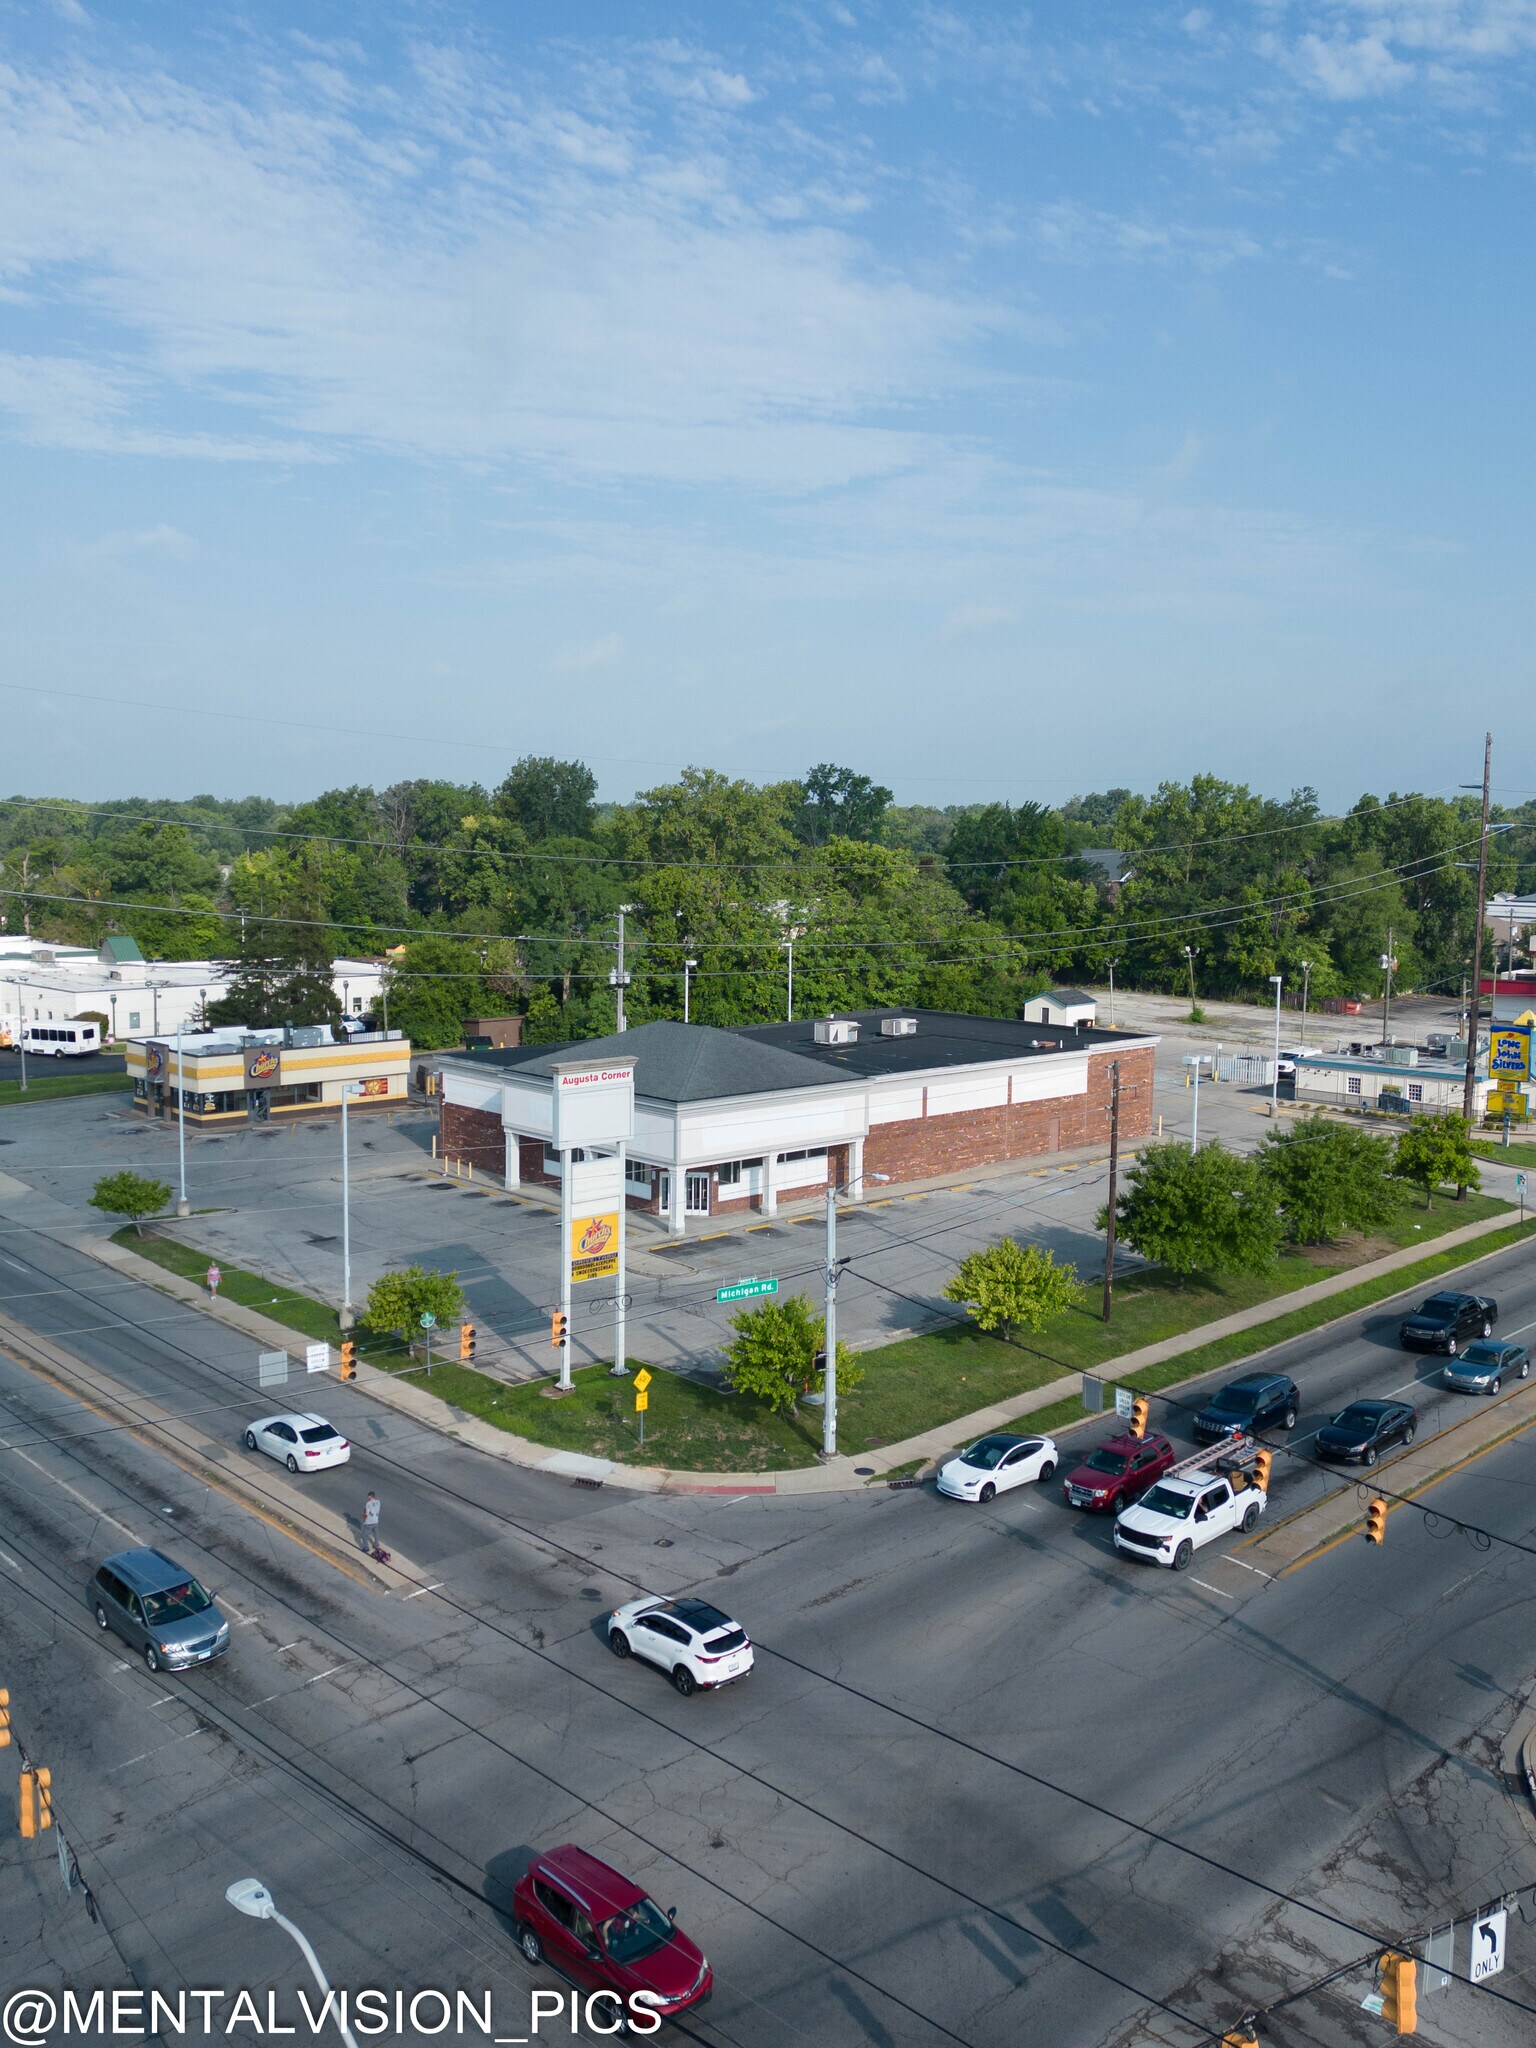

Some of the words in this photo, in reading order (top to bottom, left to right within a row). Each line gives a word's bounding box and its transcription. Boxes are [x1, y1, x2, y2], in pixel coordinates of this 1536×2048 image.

[562, 1074, 599, 1086] Augusta
[601, 1071, 631, 1080] Corner
[721, 1286, 759, 1299] Michigan
[761, 1283, 774, 1292] Rd.
[1475, 1953, 1500, 1978] ONLY
